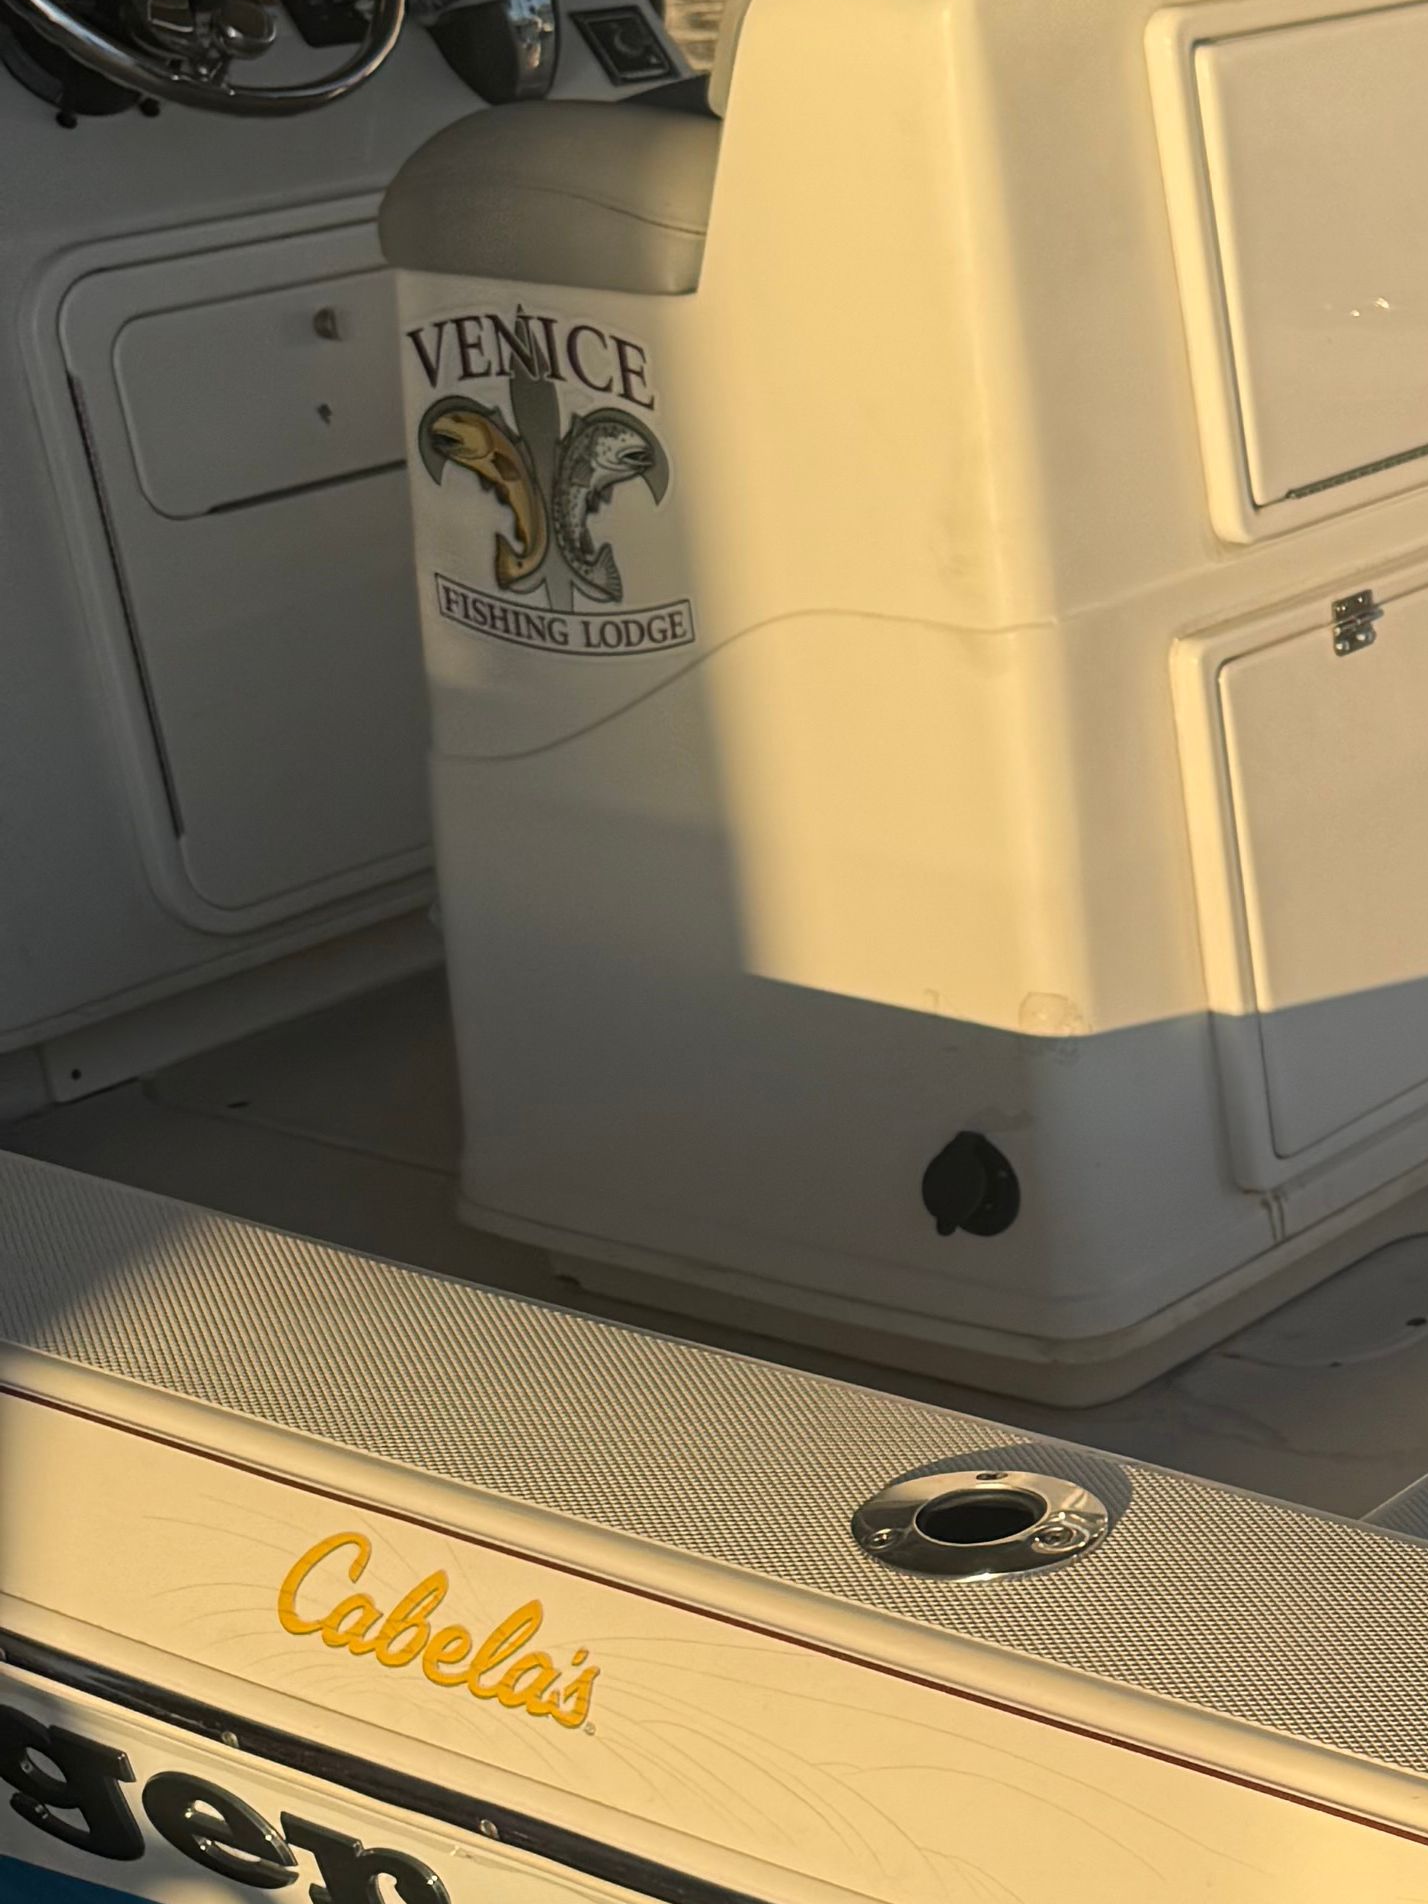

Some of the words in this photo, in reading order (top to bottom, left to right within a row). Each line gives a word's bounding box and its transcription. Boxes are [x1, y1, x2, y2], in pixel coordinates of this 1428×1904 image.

[406, 313, 656, 411] VENICE
[442, 585, 570, 647] FISHING
[581, 610, 689, 650] LODGE
[277, 1530, 600, 1729] Cabela's
